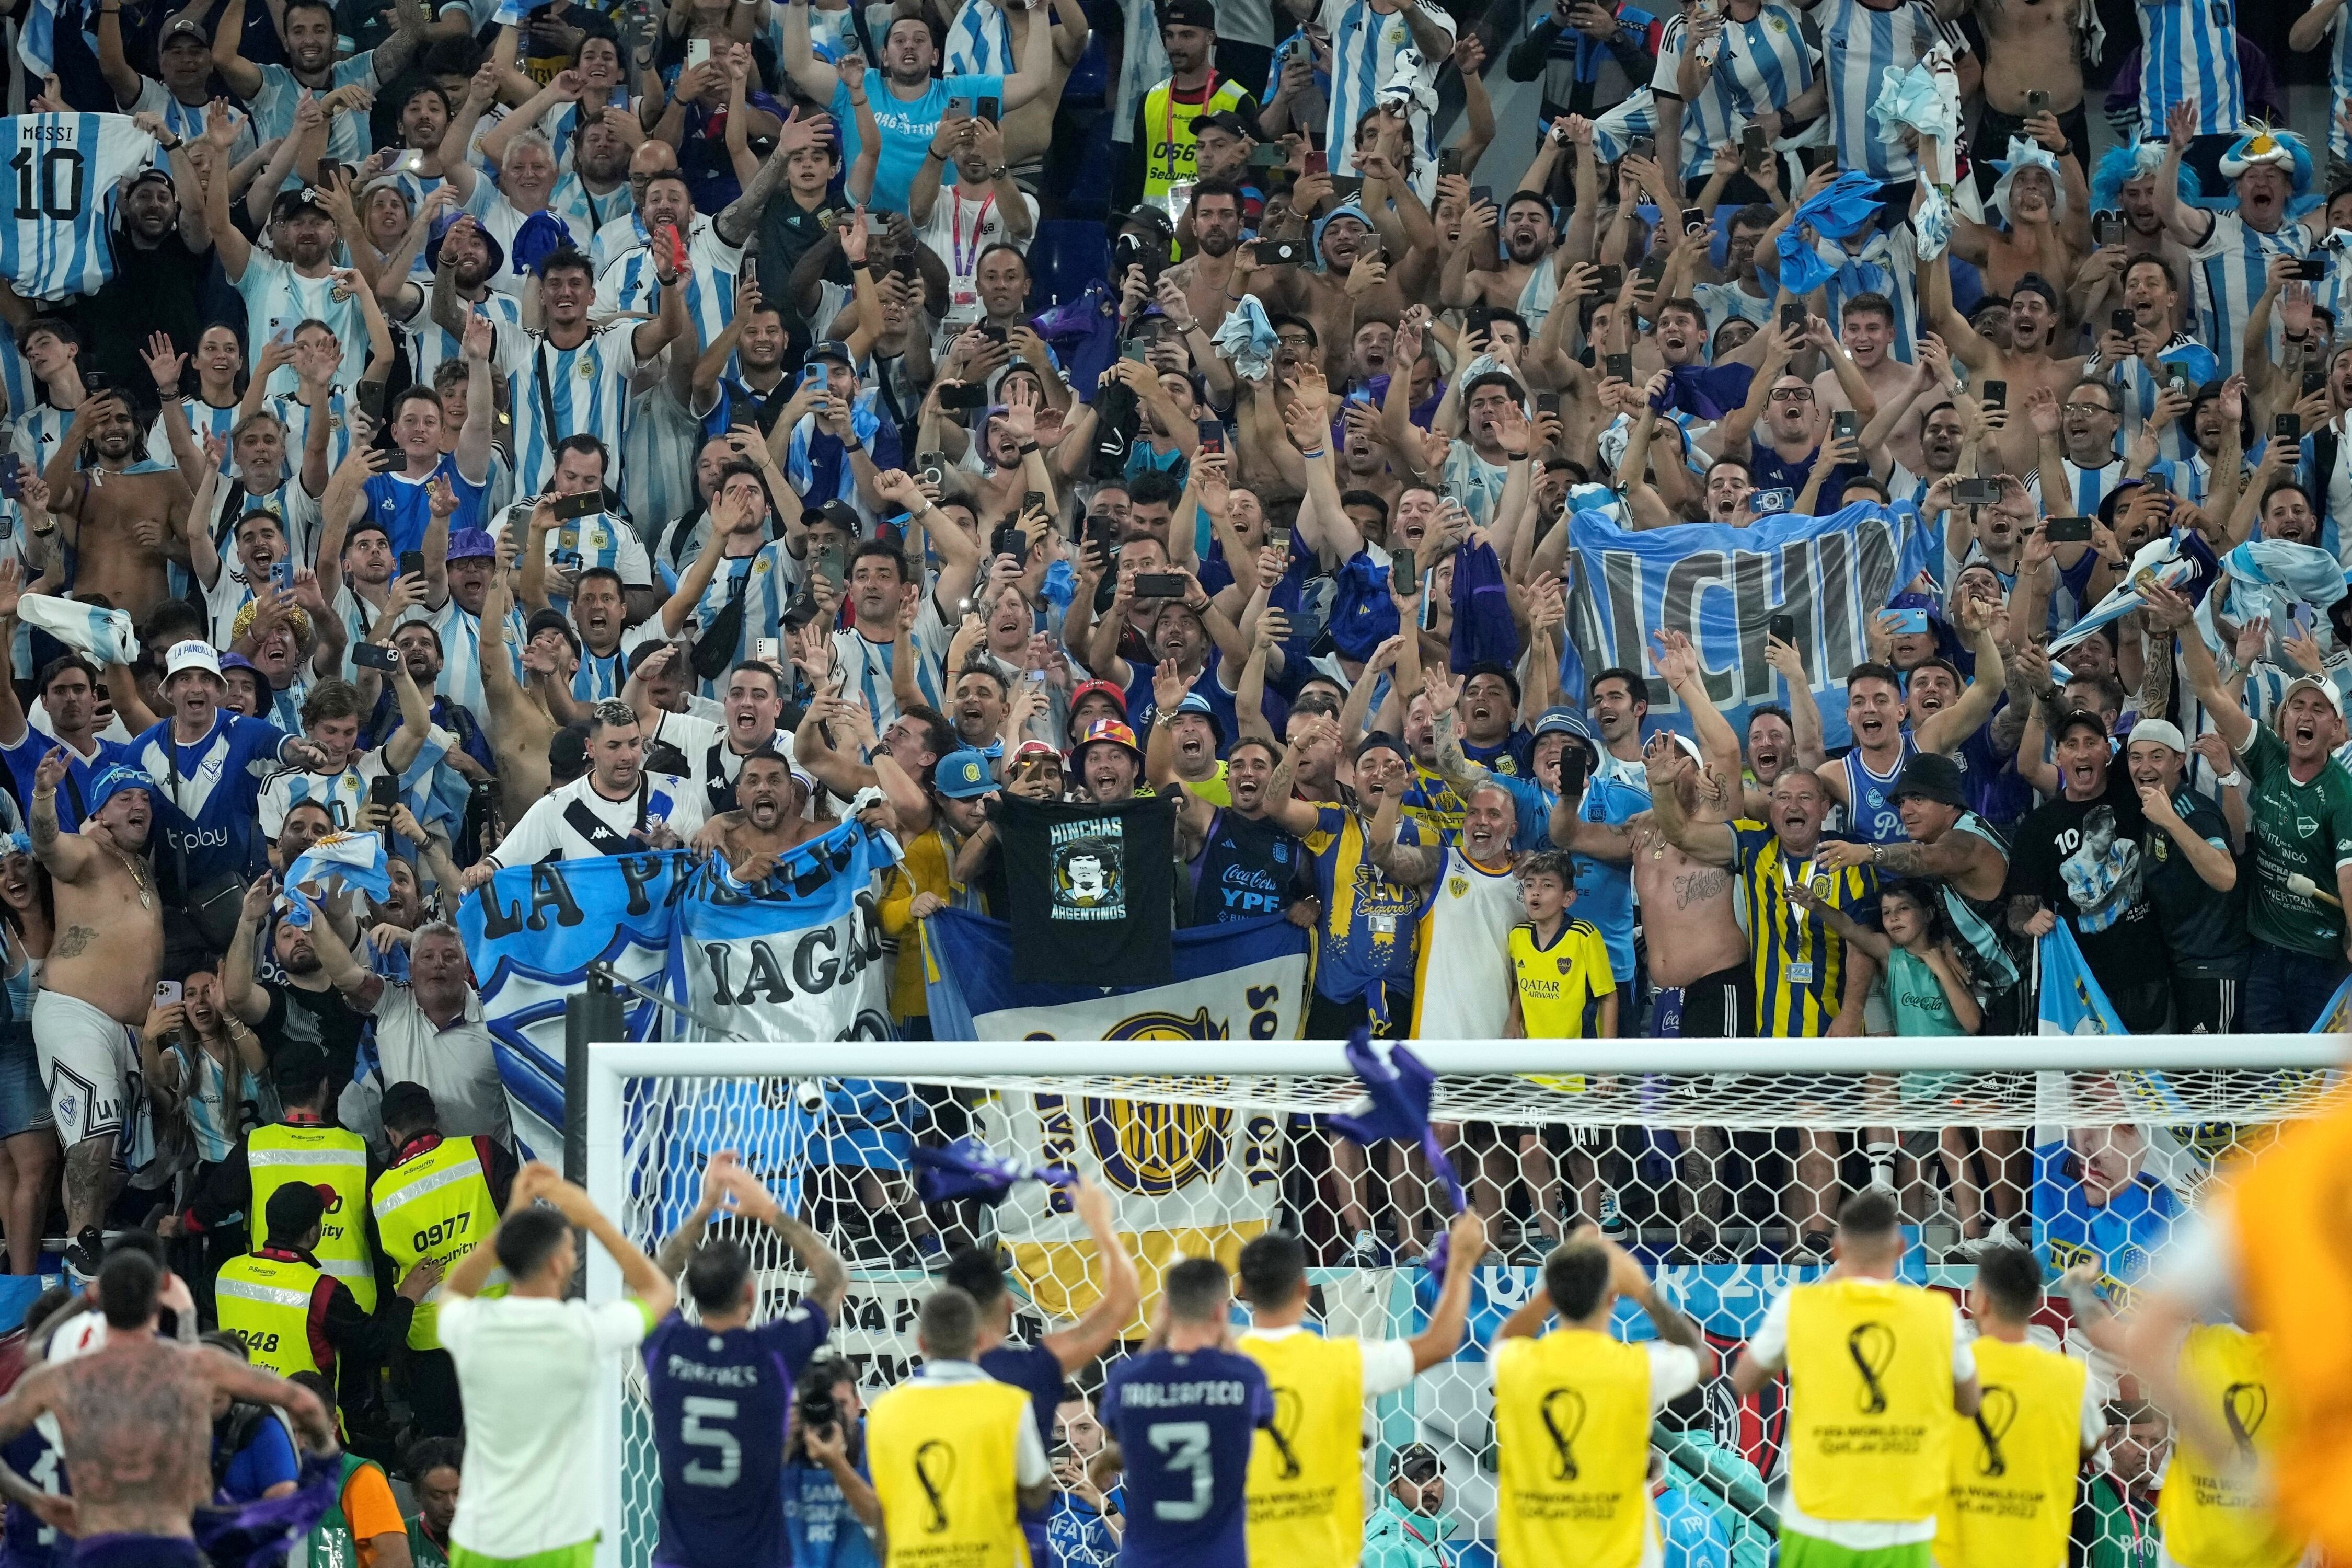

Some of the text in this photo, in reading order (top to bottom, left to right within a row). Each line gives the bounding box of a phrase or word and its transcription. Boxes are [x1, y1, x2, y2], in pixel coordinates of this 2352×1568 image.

[22, 126, 72, 142] MESSI
[9, 147, 84, 221] 10
[1148, 167, 1198, 184] Securit
[175, 647, 181, 659] LA
[1501, 762, 1512, 771] AFA
[1048, 817, 1123, 845] HINCHAS
[2054, 828, 2079, 855] 10
[1221, 888, 1281, 913] YPF
[1369, 883, 1403, 903] LN
[1051, 904, 1126, 922] ARGENTINOS
[1359, 898, 1408, 913] Seguros
[1519, 978, 1559, 993] QATAR
[1527, 991, 1559, 1000] AIRWAYS
[413, 1211, 470, 1254] 0977
[681, 1396, 742, 1488] 5
[1147, 1421, 1215, 1521] 3
[1085, 1527, 1104, 1545] TV
